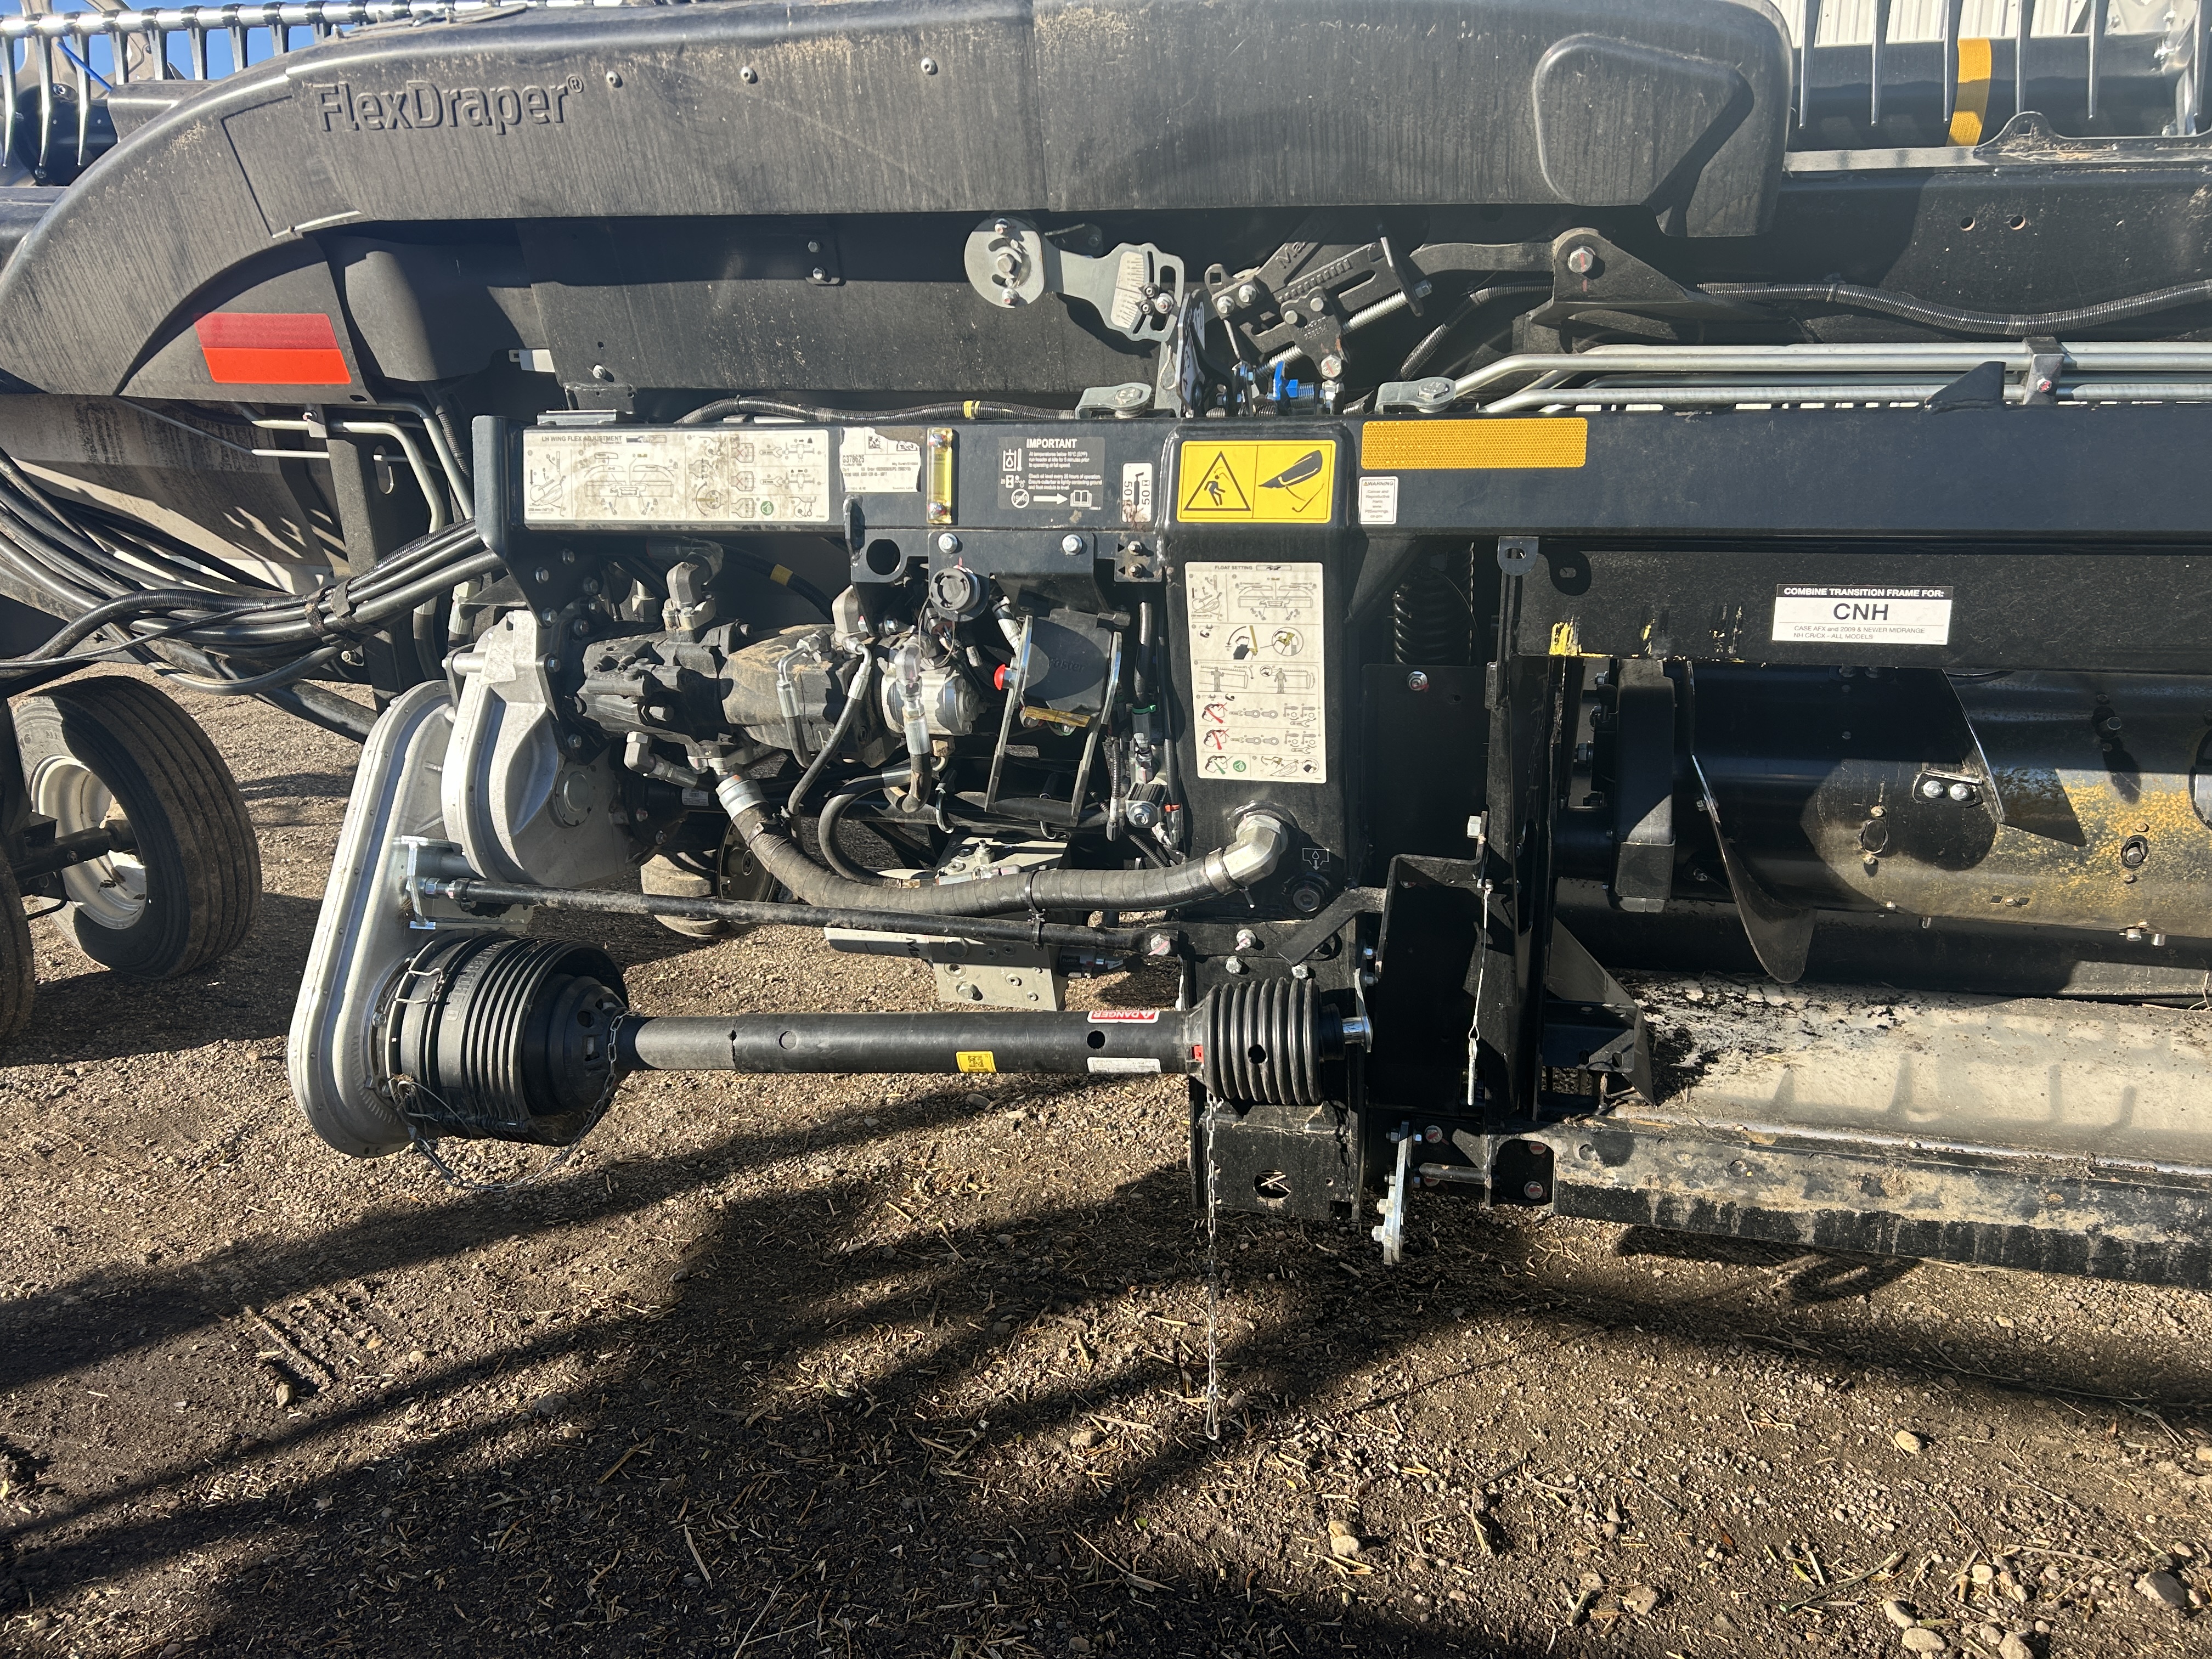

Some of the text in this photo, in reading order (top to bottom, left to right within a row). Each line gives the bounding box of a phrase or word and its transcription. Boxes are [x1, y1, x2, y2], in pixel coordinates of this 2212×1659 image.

[1026, 438, 1077, 448] IMPORTANT
[1124, 481, 1132, 496] 50
[1142, 490, 1150, 505] 50
[1829, 588, 1884, 596] TRANSITION
[1833, 603, 1888, 620] CNH
